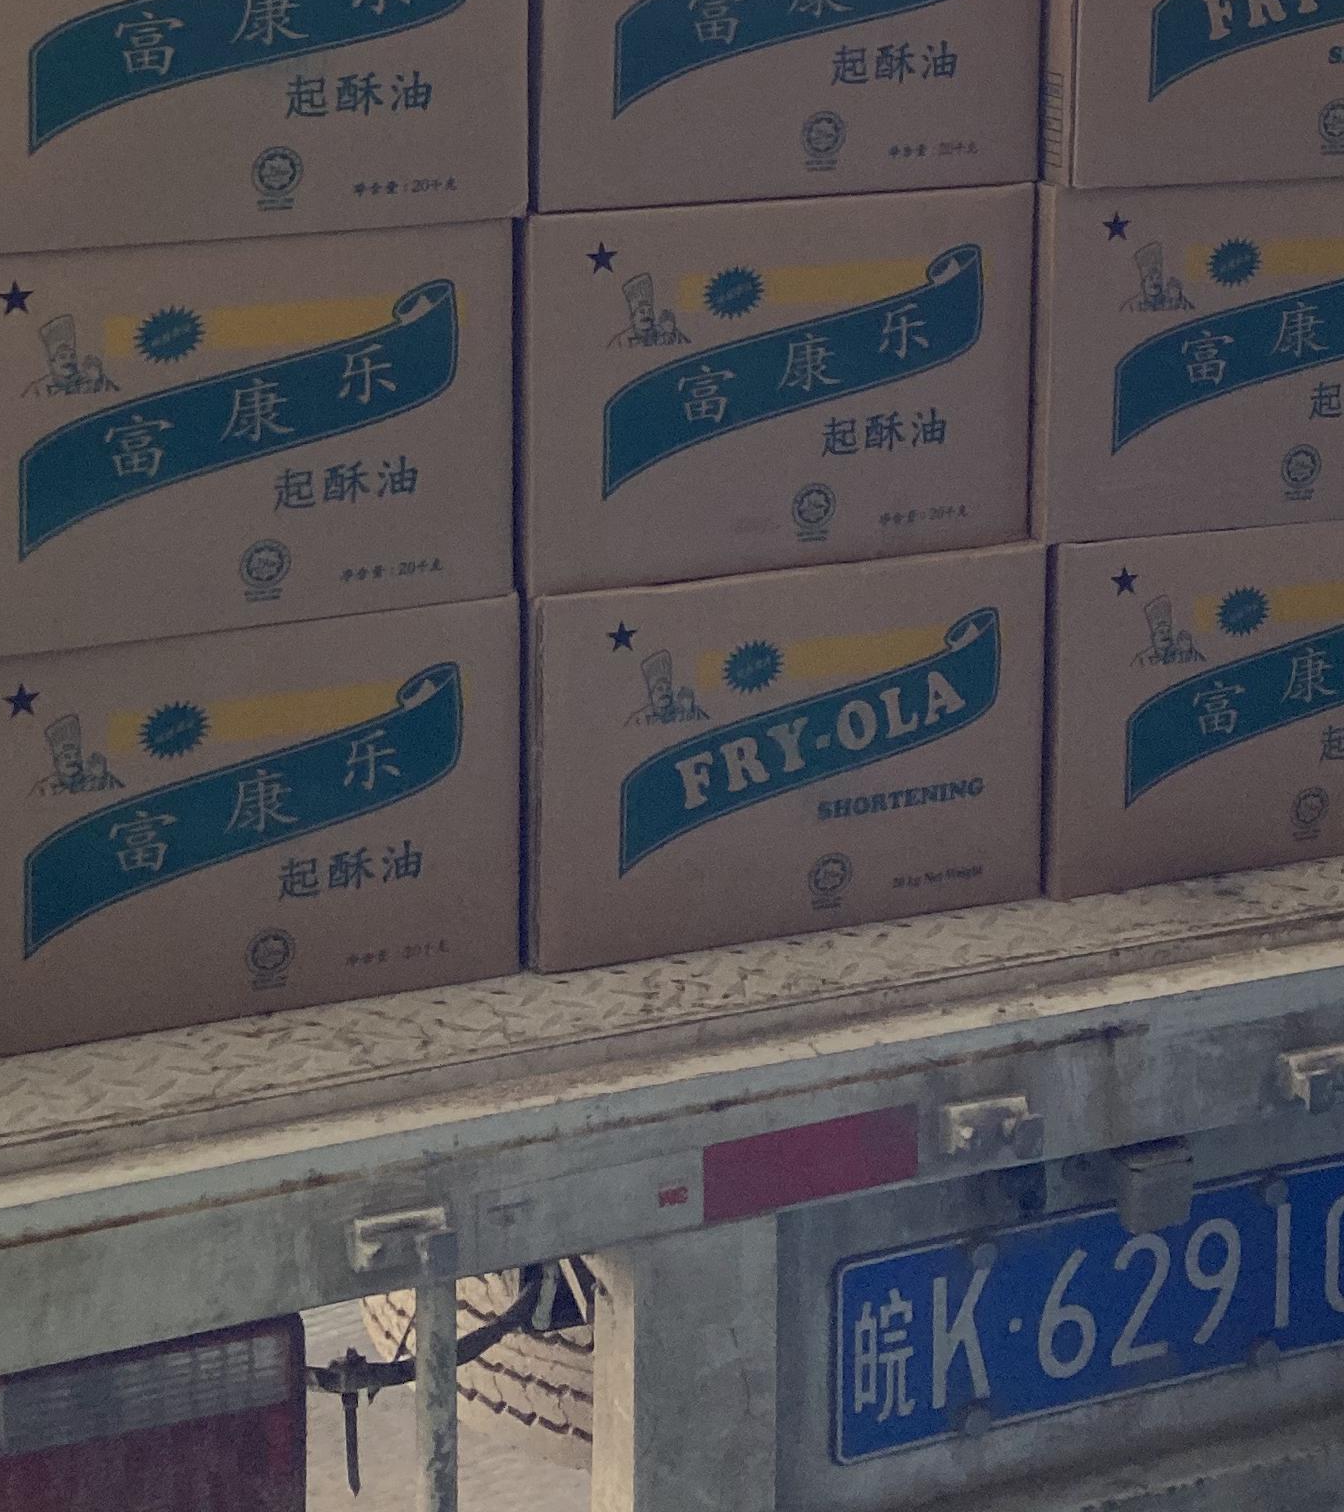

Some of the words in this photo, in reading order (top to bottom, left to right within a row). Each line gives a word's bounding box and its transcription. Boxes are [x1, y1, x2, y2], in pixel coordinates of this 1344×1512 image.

[830, 40, 957, 86] 起酥油
[285, 70, 433, 119] 起酥油
[678, 303, 929, 424] 富康乐
[103, 344, 398, 477] 富康乐
[820, 409, 946, 457] 起酥油
[273, 456, 418, 512] 起酥油
[674, 670, 965, 811] FRY-OLA
[108, 730, 402, 873] 富康乐
[817, 778, 985, 822] SHORTENING
[277, 841, 422, 901] 起酥油
